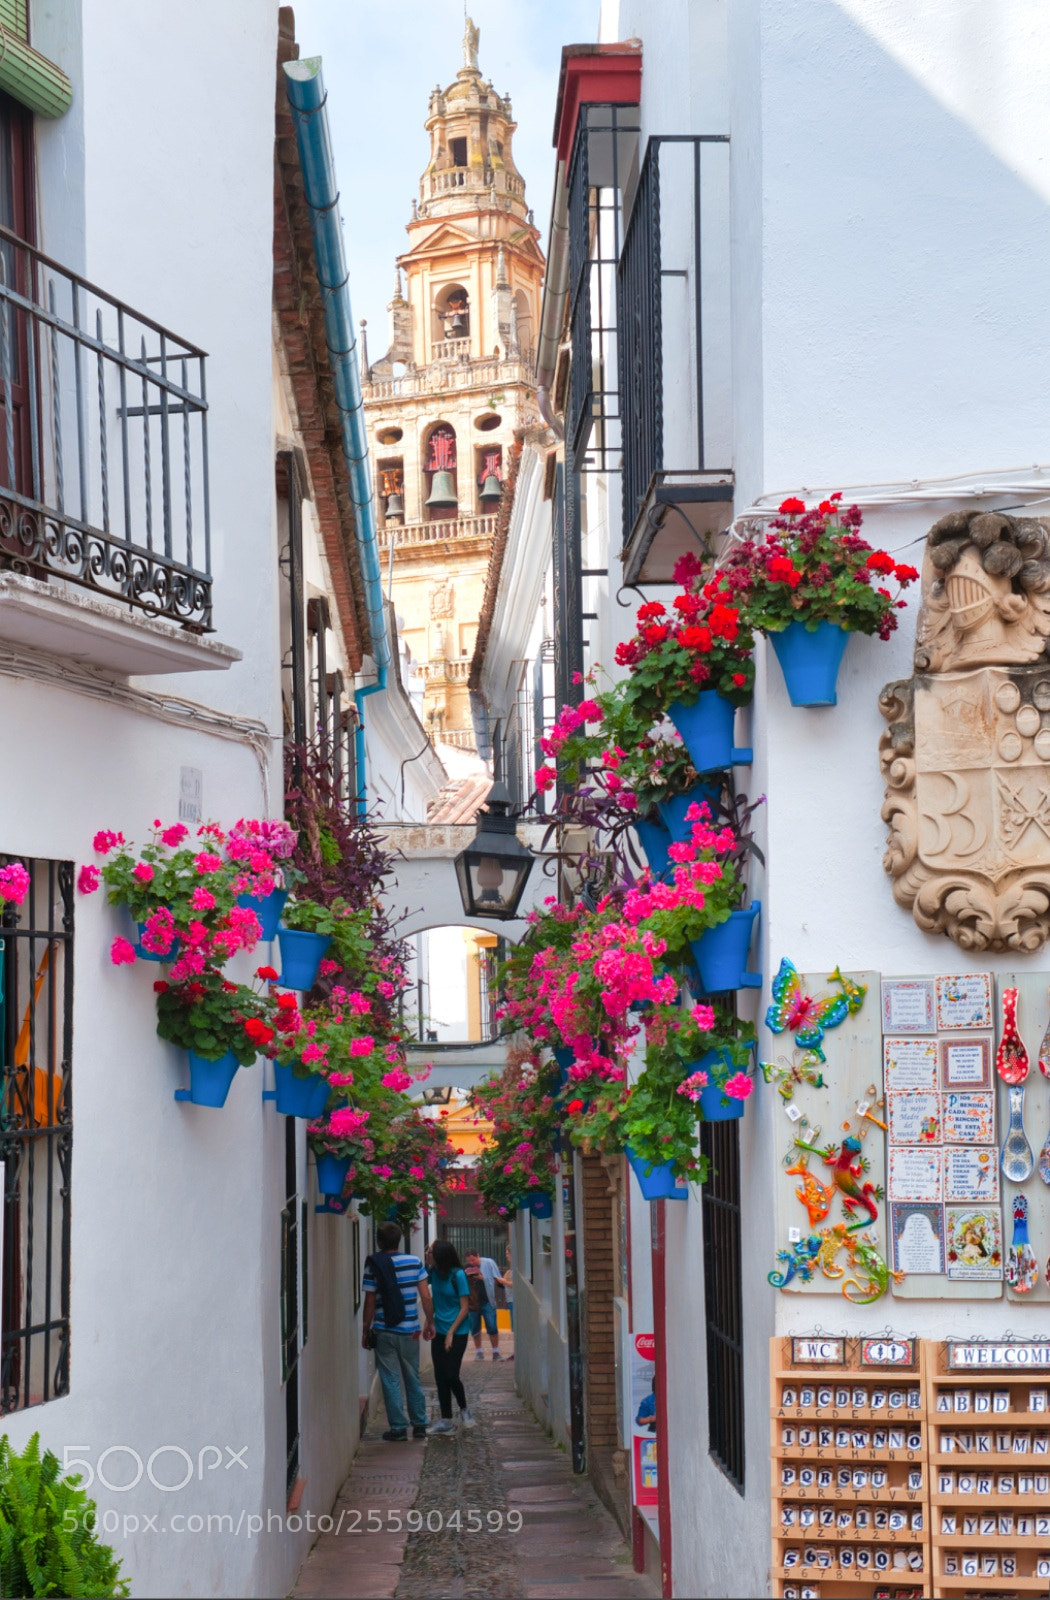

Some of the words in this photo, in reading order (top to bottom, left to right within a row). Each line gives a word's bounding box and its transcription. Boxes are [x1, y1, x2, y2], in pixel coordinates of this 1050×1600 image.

[807, 1343, 831, 1358] WC
[784, 1392, 793, 1404] A
[802, 1392, 812, 1404] B
[820, 1392, 831, 1405] C
[837, 1392, 848, 1405] D
[854, 1393, 865, 1405] E
[873, 1395, 884, 1406] F
[891, 1393, 901, 1406] G
[909, 1393, 920, 1406] H
[938, 1398, 949, 1411] A
[957, 1397, 967, 1411] B
[977, 1398, 988, 1411] D
[996, 1398, 1007, 1411] D
[1032, 1396, 1043, 1411] F
[778, 1408, 786, 1417] A
[796, 1409, 803, 1417] B
[815, 1409, 822, 1417] C
[832, 1410, 839, 1418] D
[852, 1409, 859, 1418] E
[870, 1410, 877, 1418] F
[887, 1410, 894, 1418] G
[907, 1410, 914, 1419] H
[785, 1431, 792, 1442] I
[801, 1432, 811, 1444] J
[821, 1432, 830, 1444] K
[838, 1433, 848, 1444] L
[854, 1435, 867, 1445] M
[875, 1434, 885, 1445] N
[910, 1436, 920, 1447] O
[945, 1437, 951, 1451] I
[978, 1437, 989, 1451] K
[999, 1436, 1009, 1450] L
[1014, 1439, 1026, 1452] M
[1035, 1441, 1046, 1452] N
[907, 1451, 915, 1460] O
[783, 1470, 794, 1482] P
[801, 1471, 812, 1483] Q
[821, 1473, 830, 1484] R
[840, 1472, 850, 1484] S
[854, 1473, 865, 1485] T
[873, 1473, 884, 1485] U
[910, 1474, 922, 1487] W
[940, 1478, 951, 1492] P
[960, 1478, 971, 1492] Q
[979, 1480, 989, 1493] R
[1001, 1478, 1012, 1492] S
[1021, 1477, 1033, 1492] T
[1036, 1478, 1047, 1492] U
[835, 1490, 843, 1498] S
[852, 1490, 860, 1499] T
[871, 1491, 879, 1499] U
[889, 1491, 896, 1500] V
[907, 1491, 916, 1499] W
[783, 1510, 793, 1523] X
[802, 1511, 813, 1524] Y
[823, 1511, 833, 1524] Z
[858, 1512, 868, 1524] 1
[876, 1513, 887, 1524] 2
[891, 1516, 902, 1527] 3
[943, 1519, 954, 1532] X
[966, 1519, 976, 1532] Y
[983, 1521, 994, 1533] Z
[1020, 1521, 1027, 1533] 1
[1038, 1520, 1049, 1534] 2
[800, 1529, 808, 1537] Y
[817, 1529, 825, 1537] Z
[853, 1531, 861, 1539] 1
[872, 1531, 880, 1539] 2
[889, 1531, 896, 1540] 3
[911, 1532, 918, 1540] 4
[785, 1554, 797, 1565] 5
[806, 1550, 816, 1562] 6
[819, 1557, 830, 1566] 7
[841, 1552, 852, 1563] 8
[859, 1552, 869, 1564] 9
[877, 1552, 888, 1566] 0
[946, 1558, 956, 1572] 5
[965, 1560, 975, 1574] 6
[985, 1559, 996, 1573] 7
[1004, 1558, 1015, 1573] 8
[1039, 1561, 1050, 1575] 0
[783, 1569, 790, 1577] 5
[801, 1569, 808, 1577] 6
[819, 1569, 826, 1578] 7
[836, 1570, 843, 1578] 8
[854, 1570, 861, 1580] 9
[872, 1571, 881, 1580] 0
